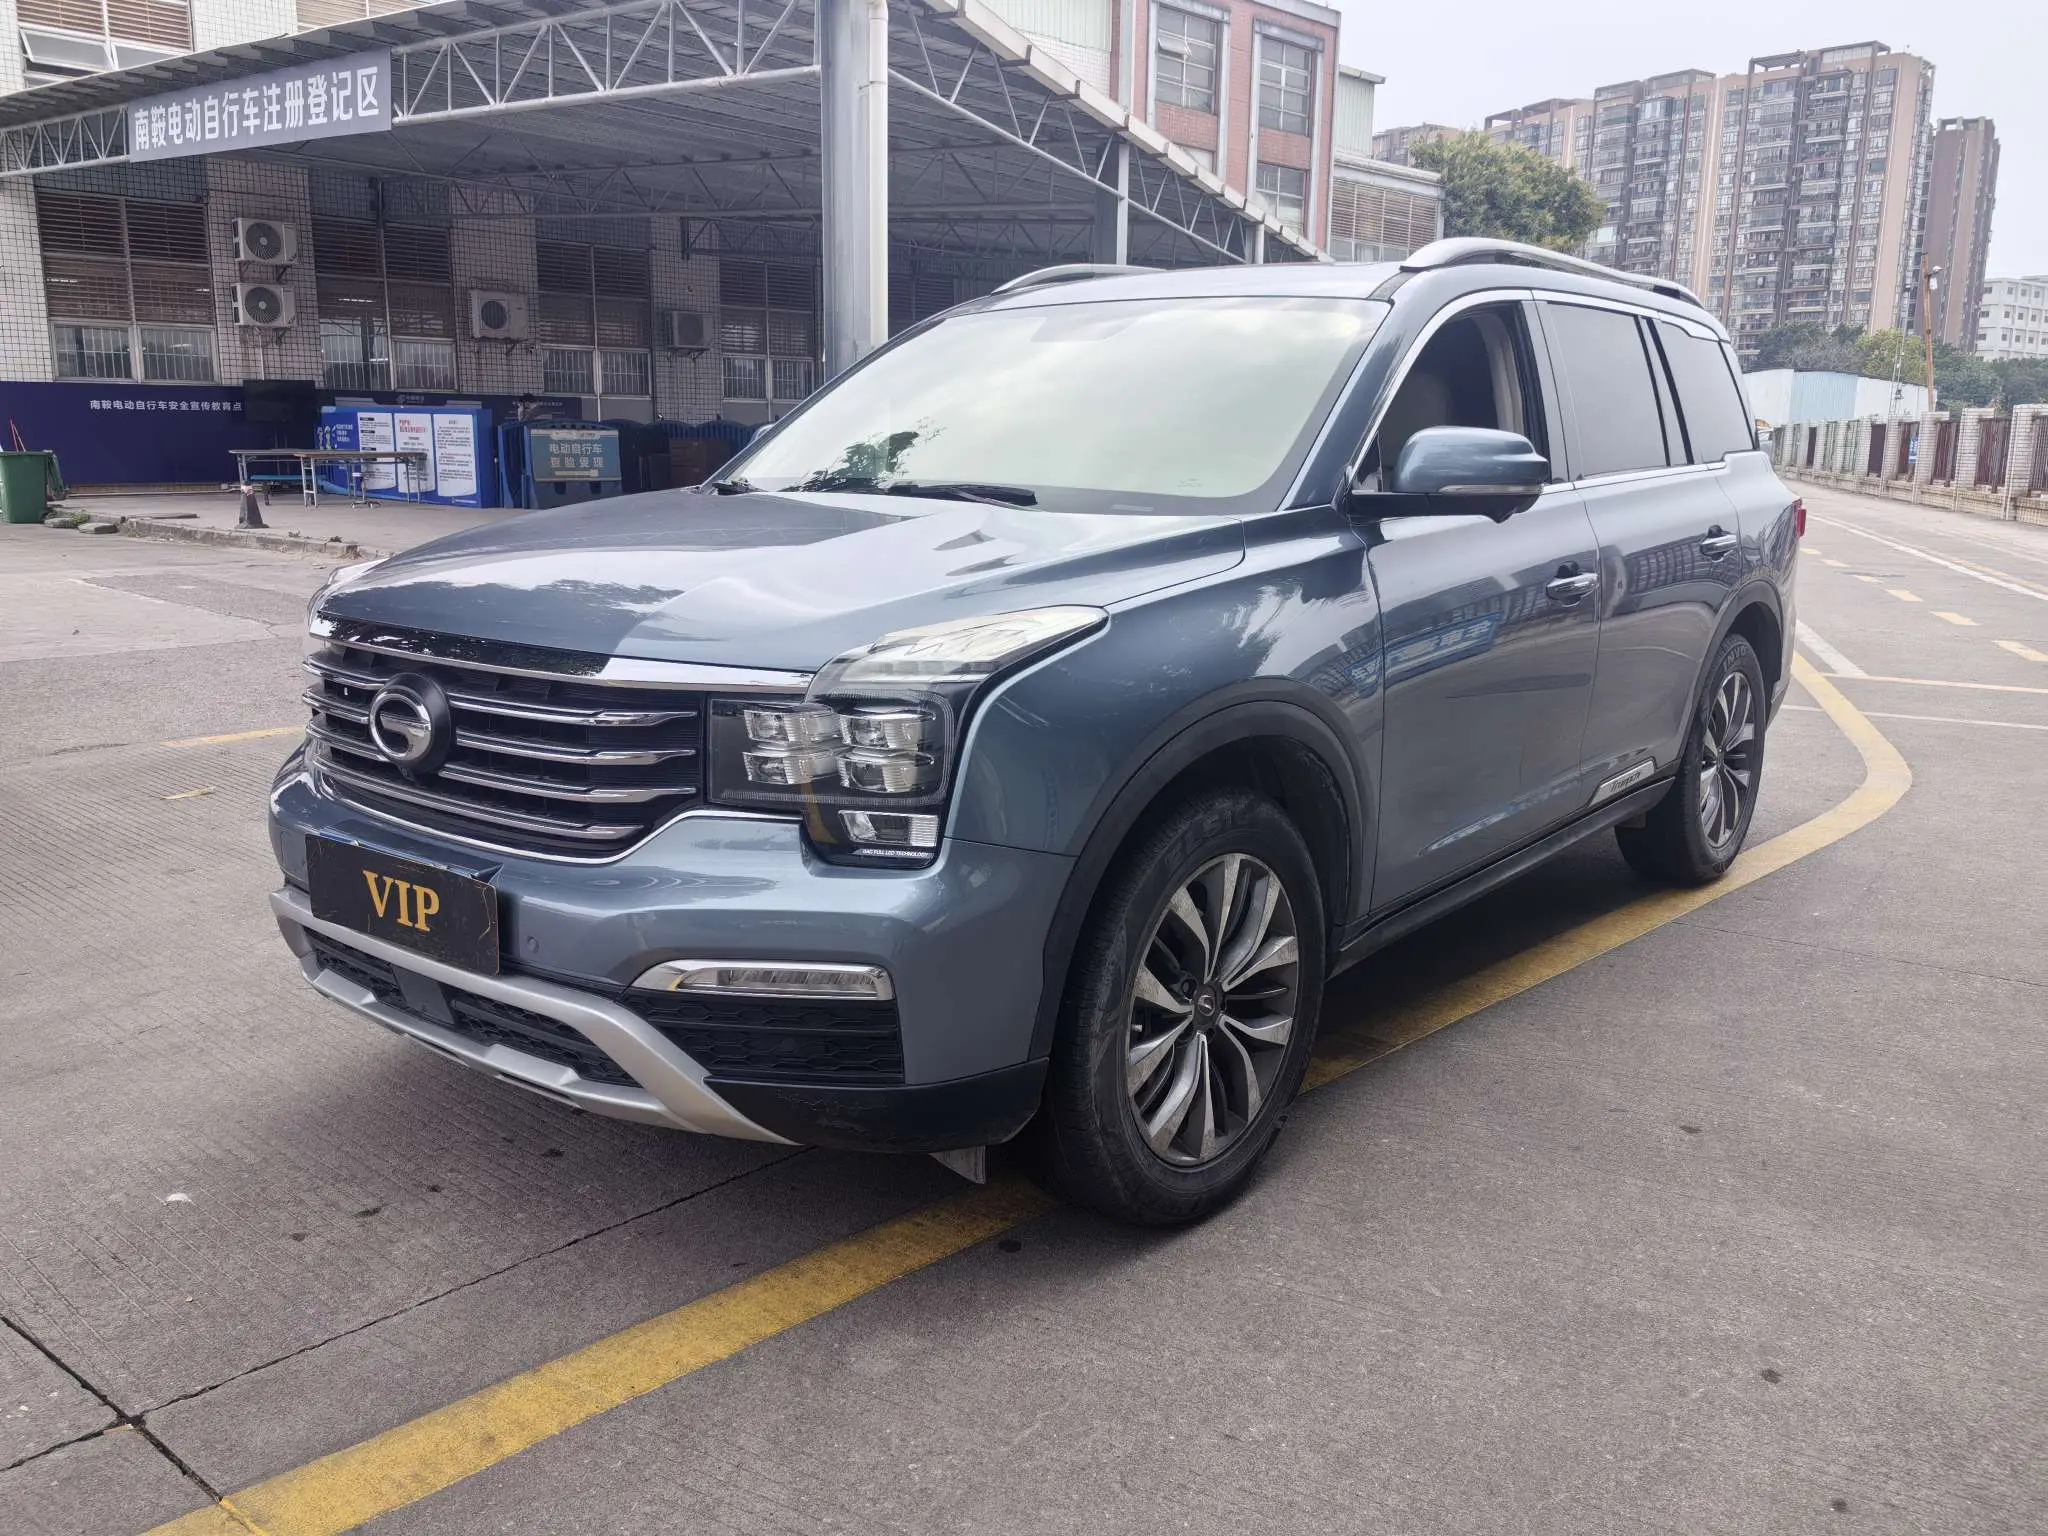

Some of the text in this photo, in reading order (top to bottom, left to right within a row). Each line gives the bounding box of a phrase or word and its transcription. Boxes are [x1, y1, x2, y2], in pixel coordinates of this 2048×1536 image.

[134, 66, 380, 151] 南鞍电动自行车注册登记区
[90, 400, 243, 411] 南鞍电动自行车安全宣传教育点
[549, 443, 603, 454] 电动自行车
[362, 869, 440, 932] VIP
